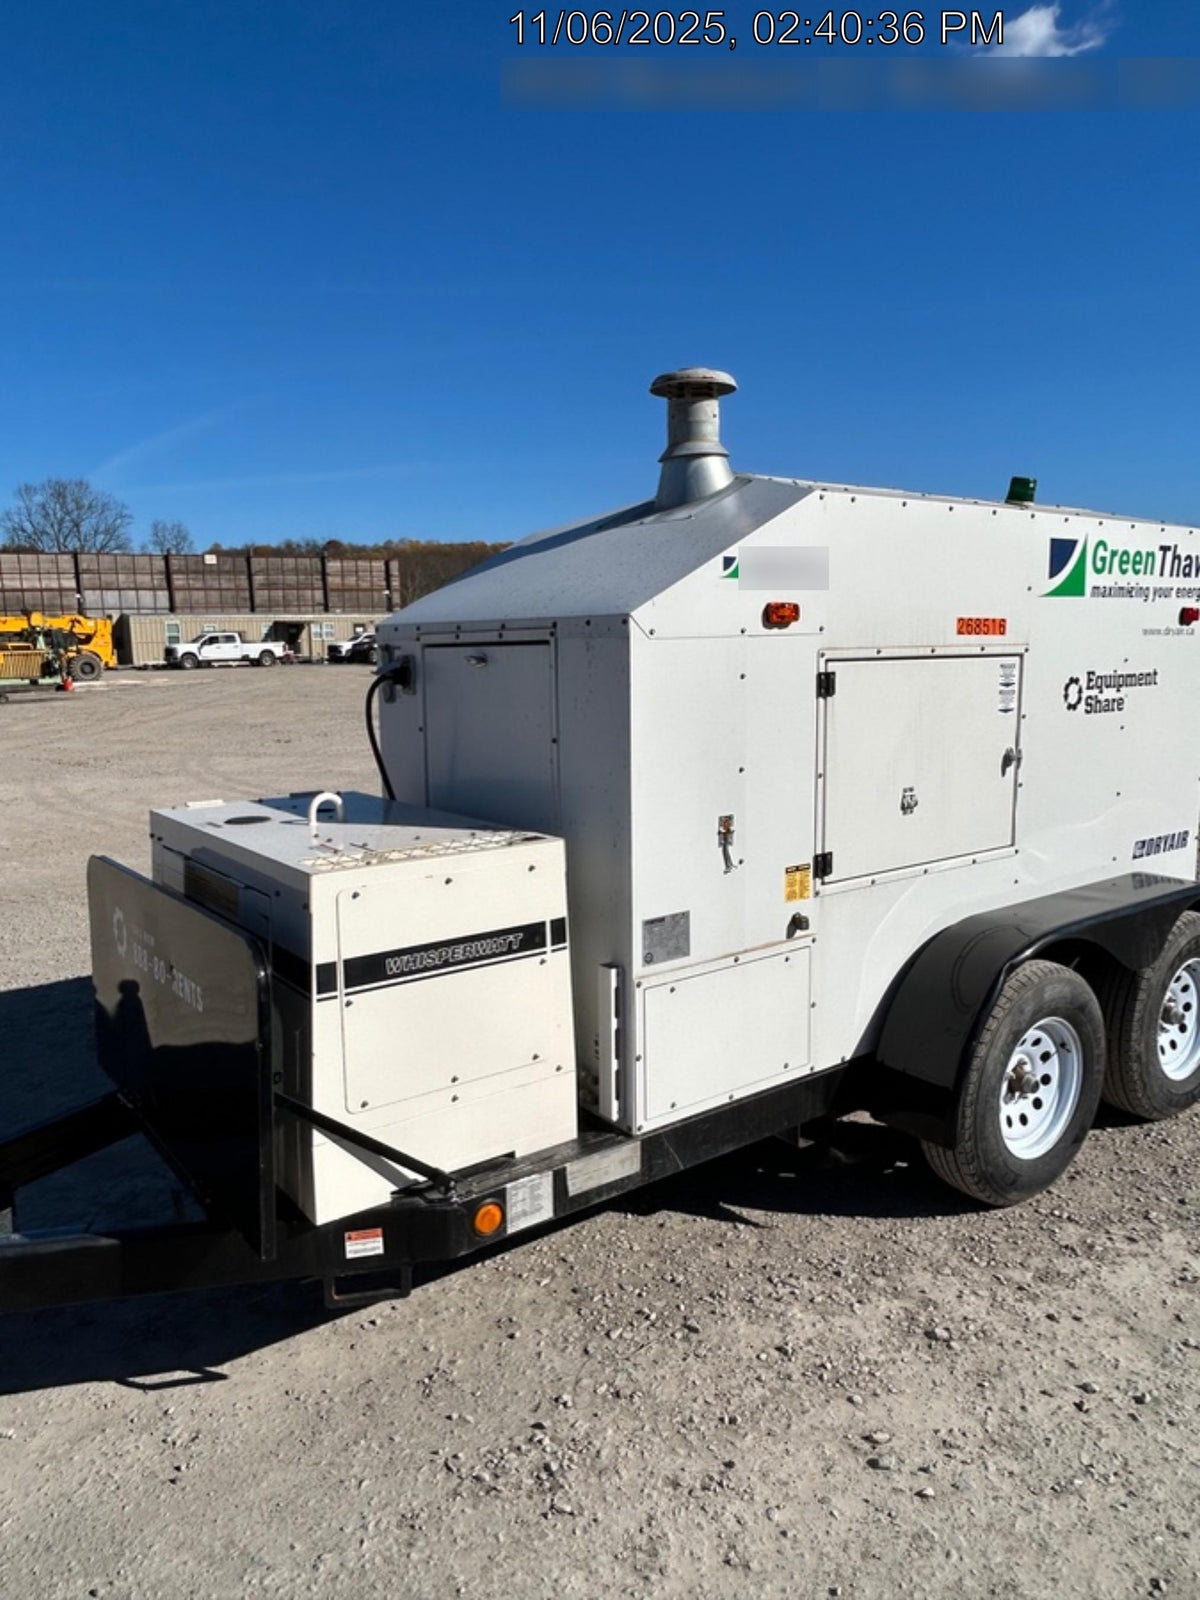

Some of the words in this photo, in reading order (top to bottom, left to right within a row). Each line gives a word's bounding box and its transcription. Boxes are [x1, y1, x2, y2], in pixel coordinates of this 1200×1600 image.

[1090, 581, 1150, 602] maximizing
[1151, 586, 1173, 602] your
[957, 617, 1006, 635] 268516
[1086, 668, 1158, 694] Equipment
[1084, 694, 1125, 714] Share
[385, 932, 524, 975] WHISPERWATT
